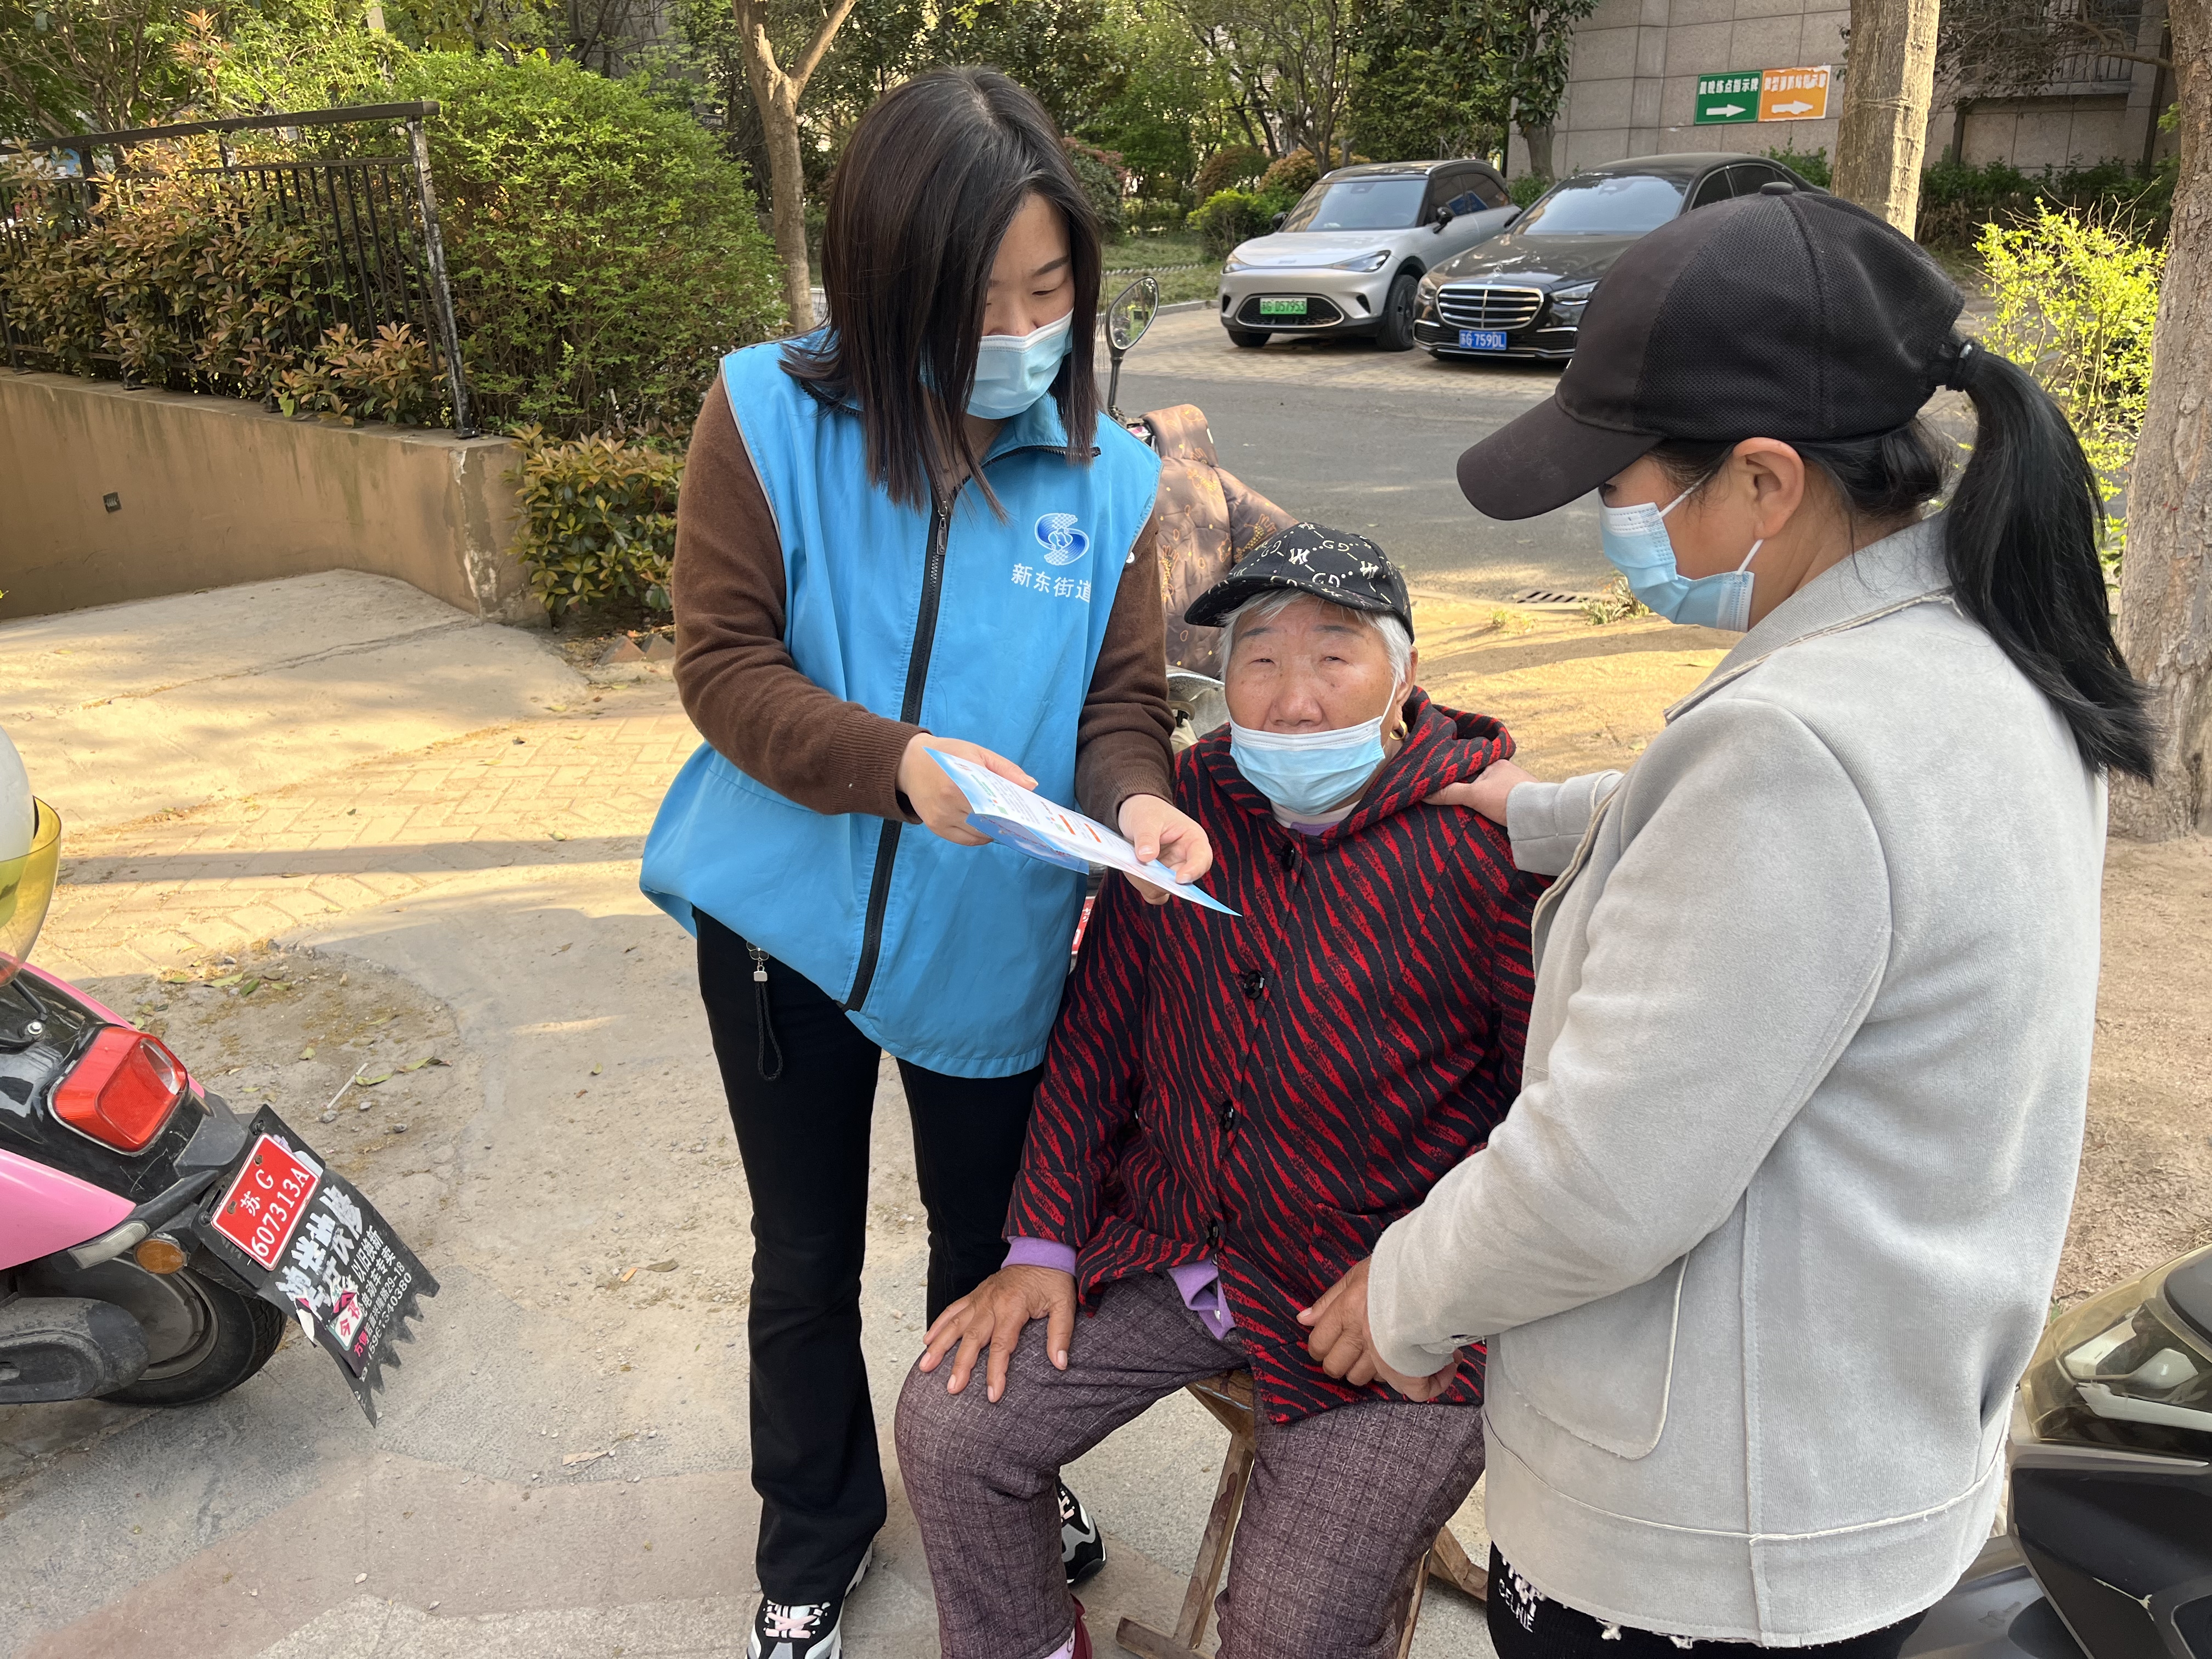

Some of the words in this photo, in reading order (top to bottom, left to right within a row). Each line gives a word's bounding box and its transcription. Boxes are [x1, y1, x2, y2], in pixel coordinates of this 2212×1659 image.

[1011, 563, 1092, 603] 新东街道
[251, 1167, 310, 1257] 607313A
